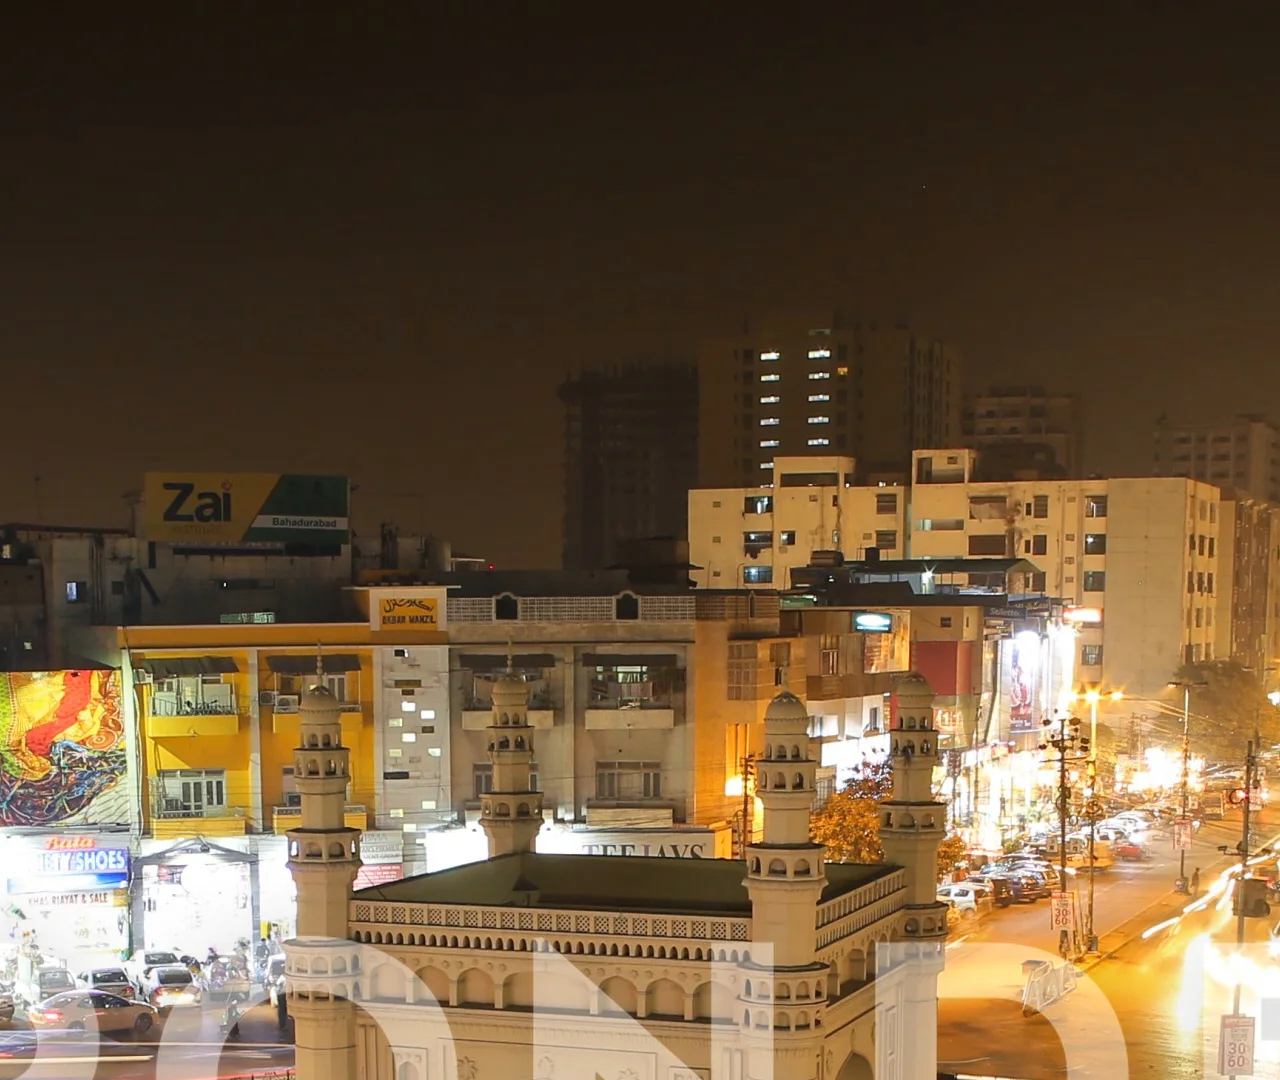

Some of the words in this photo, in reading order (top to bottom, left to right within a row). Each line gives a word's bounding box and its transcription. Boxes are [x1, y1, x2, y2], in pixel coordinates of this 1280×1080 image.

[163, 479, 233, 523] Zai
[272, 517, 337, 528] Bahadurabad
[409, 615, 436, 624] MANZIL
[75, 850, 125, 870] SHOES
[81, 893, 87, 904] &
[89, 892, 108, 903] SALE
